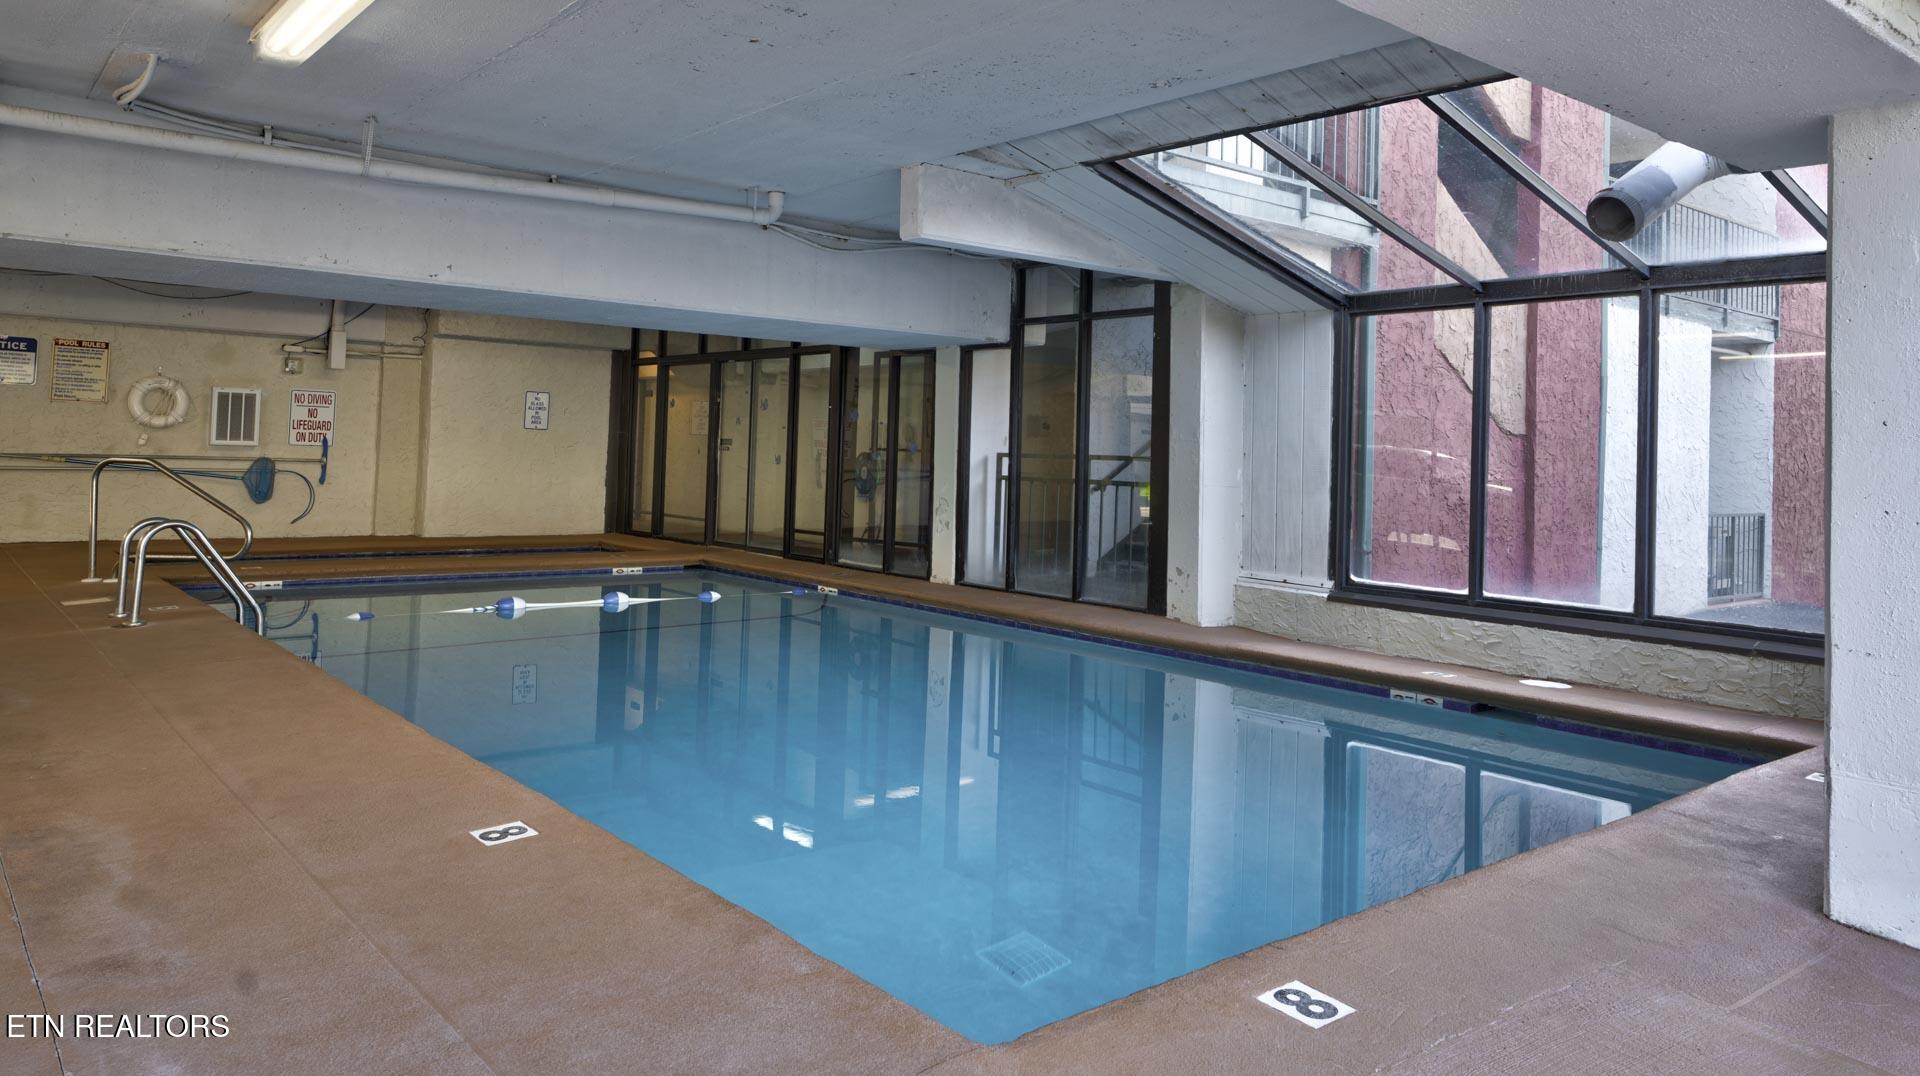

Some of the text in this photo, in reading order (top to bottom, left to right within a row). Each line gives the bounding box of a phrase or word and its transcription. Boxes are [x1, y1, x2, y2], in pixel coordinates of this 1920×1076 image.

[294, 393, 333, 405] NO DIVING
[307, 408, 318, 418] NO
[292, 420, 332, 431] LIFEGUARD
[295, 431, 306, 442] ON
[479, 826, 528, 841] 8
[1274, 988, 1338, 1019] 8
